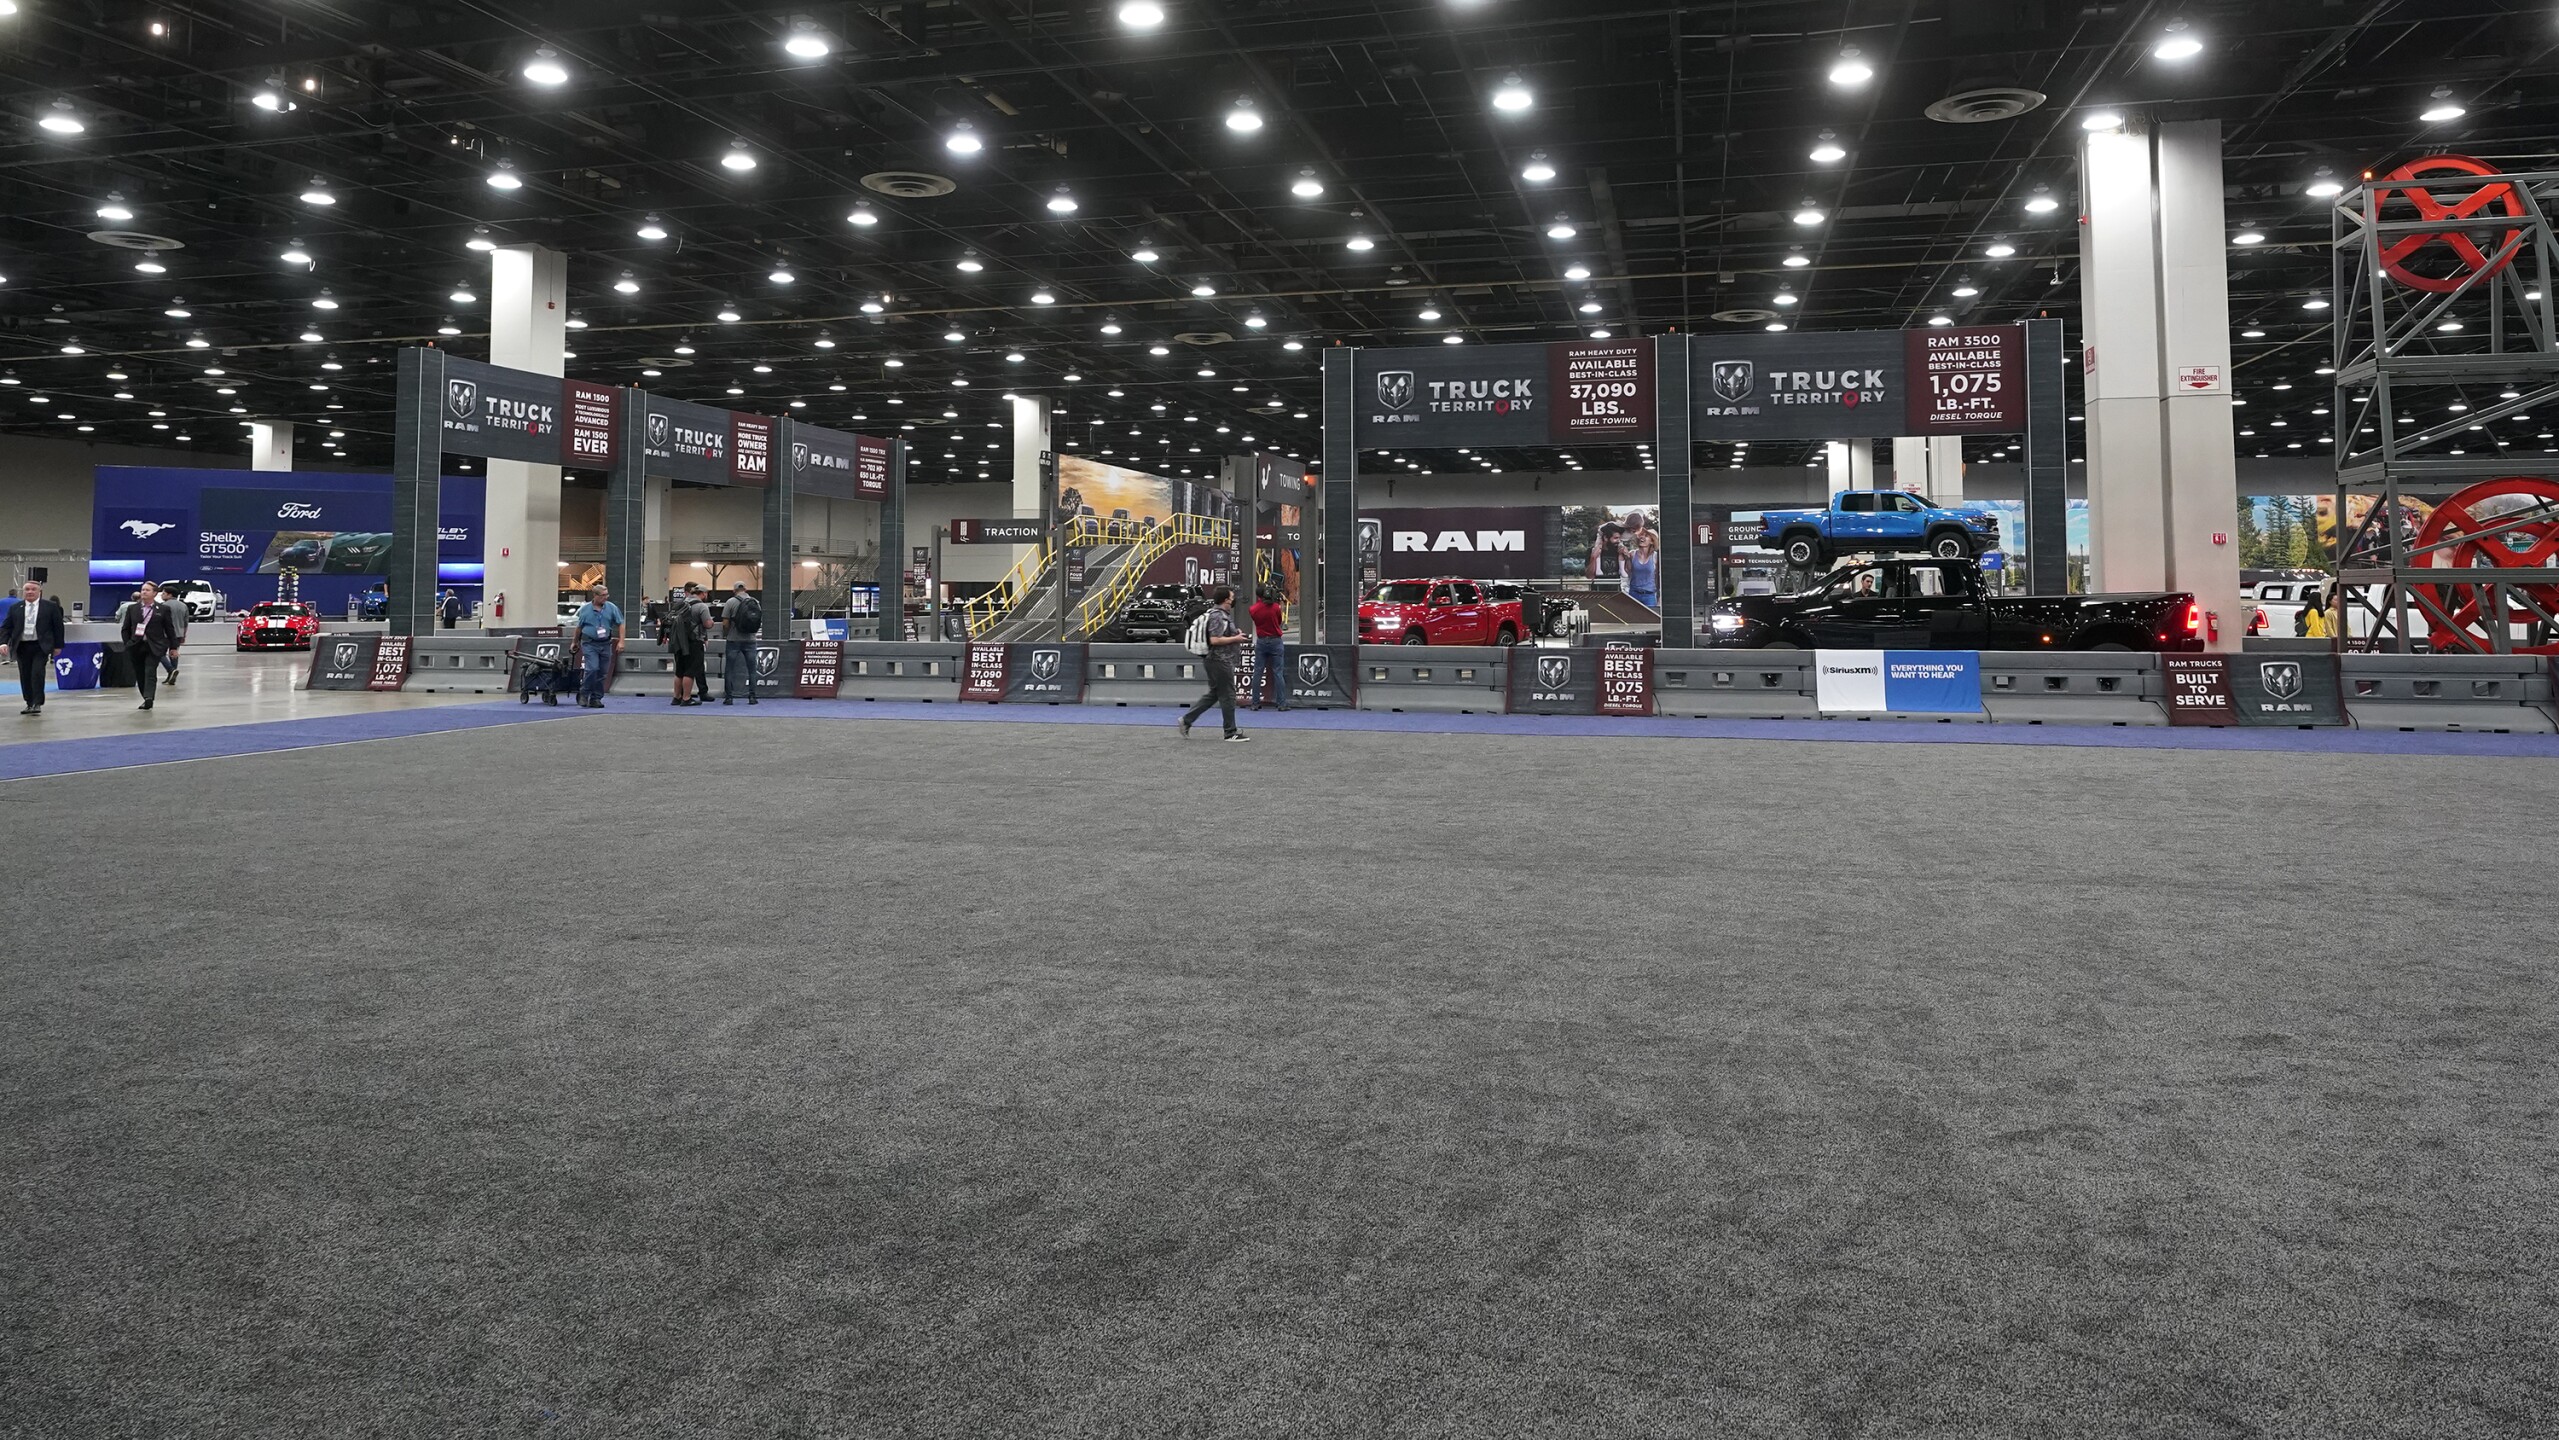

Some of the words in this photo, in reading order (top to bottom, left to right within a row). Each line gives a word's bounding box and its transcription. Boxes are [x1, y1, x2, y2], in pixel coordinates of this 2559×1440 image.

[1928, 337, 1959, 347] RAM
[1964, 335, 2000, 346] 3500
[1929, 350, 2001, 361] AVAILABLE
[1569, 359, 1637, 370] AVAILABLE
[1928, 360, 2001, 370] BEST-IN-CLASS
[1569, 369, 1638, 379] BEST-IN-CLASS
[1769, 369, 1885, 391] TRUCK
[1929, 373, 2002, 397] 1,075
[1428, 379, 1533, 399] TRUCK
[1569, 382, 1637, 400] 37,090
[575, 390, 592, 400] RAM
[593, 393, 610, 403] 1500
[1770, 390, 1886, 407] TERRITORY
[486, 396, 552, 422] TRUCK
[1429, 399, 1533, 414] TERRITORY
[1582, 400, 1625, 416] LBS.
[1936, 397, 1995, 410] LB.-FT.
[1706, 406, 1760, 416] RAM
[1930, 413, 1962, 421] DIESEL
[1965, 412, 2003, 420] TORQUE
[575, 415, 609, 426] ADVANCED
[1372, 414, 1421, 423] RAM
[1570, 418, 1600, 426] DIESEL
[1602, 417, 1637, 425] TOWING
[443, 420, 480, 432] RAM
[485, 415, 552, 436] TERRITORY
[574, 428, 590, 438] RAM
[592, 431, 608, 440] 1500
[674, 427, 723, 448] TRUCK
[738, 432, 751, 440] MORE
[752, 434, 767, 442] TRUCK
[573, 437, 608, 454] EVER
[674, 443, 724, 459] TERRITORY
[737, 440, 767, 451] OWNERS
[645, 448, 670, 458] RAM
[737, 454, 766, 472] RAM
[810, 453, 850, 470] RAM
[867, 463, 875, 472] 702
[859, 471, 869, 479] 650
[862, 480, 882, 489] TORQUE
[277, 502, 322, 519] Ford
[984, 527, 1038, 536] TRACTION
[200, 532, 245, 544] Shelby
[1392, 530, 1525, 552] RAM
[378, 646, 406, 656] BEST
[972, 652, 1003, 662] BEST
[375, 663, 402, 674] 1,075
[1604, 660, 1644, 671] BEST
[1890, 664, 1944, 672] EVERYTHING
[1945, 664, 1963, 672] YOU
[800, 675, 835, 685] EVER
[970, 670, 1002, 679] 37,090
[1891, 671, 1917, 679] WANT
[1917, 671, 1930, 679] TO
[1931, 671, 1955, 679] HEAR
[2176, 673, 2219, 684] BUILT
[974, 679, 995, 688] LBS.
[1604, 681, 1644, 695] 1,075
[1292, 689, 1333, 697] RAM
[2189, 685, 2208, 694] TO
[1532, 693, 1575, 701] RAM
[1607, 694, 1640, 703] LB.-FT.
[2175, 694, 2226, 706] SERVE
[2260, 703, 2313, 712] RAM
